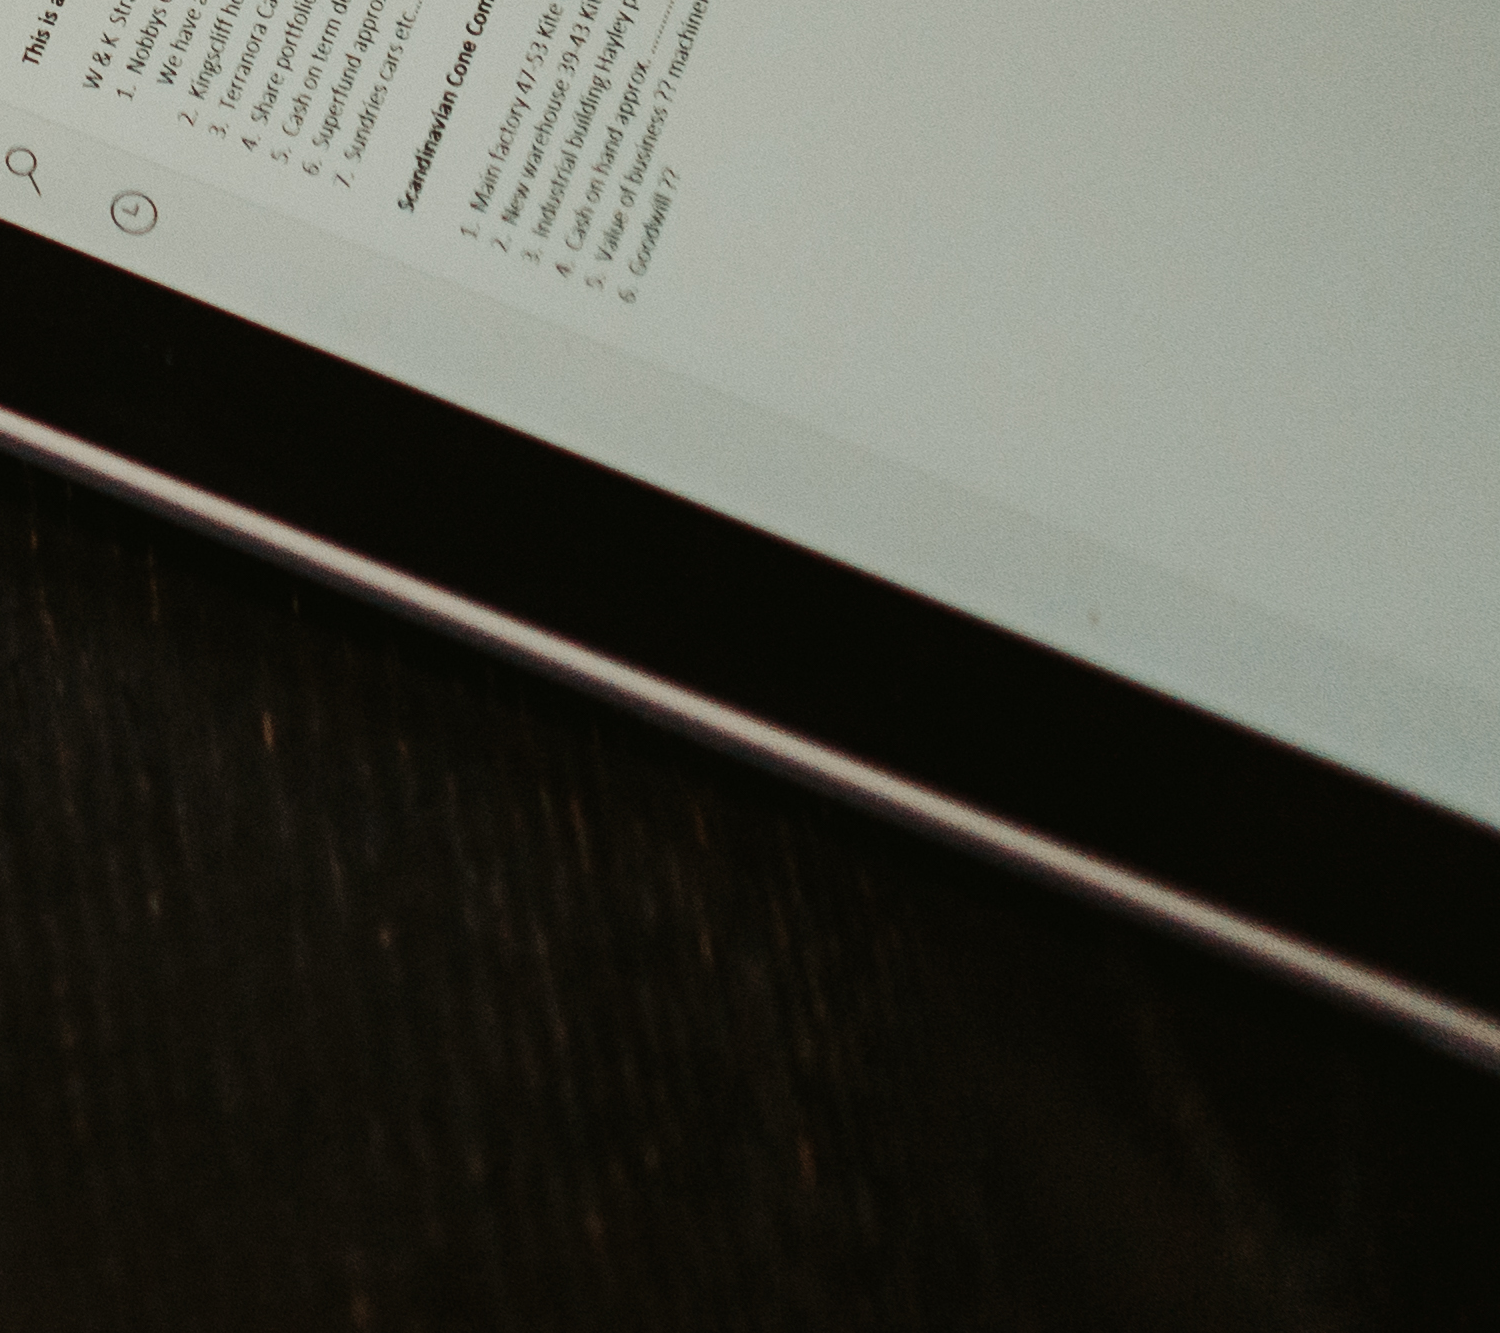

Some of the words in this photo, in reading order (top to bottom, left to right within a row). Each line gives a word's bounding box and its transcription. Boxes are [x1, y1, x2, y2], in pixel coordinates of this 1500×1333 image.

[21, 28, 51, 64] This
[37, 10, 58, 26] is
[91, 51, 112, 66] &
[101, 32, 117, 47] K
[125, 8, 166, 74] Nobbys
[157, 55, 178, 85] We
[169, 7, 199, 52] have
[189, 17, 231, 99] Kingscliff
[310, 17, 341, 61] term
[83, 67, 103, 89] W
[218, 22, 267, 109] Terranora
[302, 65, 322, 90] on
[653, 78, 675, 101] ??
[250, 72, 281, 122] Share
[281, 93, 311, 136] Cash
[311, 53, 362, 146] Superfund
[343, 84, 387, 159] Sundries
[378, 44, 403, 81] cars
[468, 165, 499, 212] Main
[488, 96, 530, 161] factory
[515, 40, 548, 94] 47-53
[536, 3, 560, 39] Kite
[500, 182, 529, 224] New
[523, 79, 566, 178] warehouse
[559, 22, 590, 71] 39-43
[397, 90, 455, 210] Scandinavian
[445, 40, 476, 87] Cone
[533, 150, 576, 237] Industrial
[566, 74, 611, 148] building
[595, 10, 634, 72] Hayley
[625, 106, 667, 184] business
[593, 125, 623, 175] hand
[585, 178, 603, 203] on
[619, 184, 635, 207] of
[564, 206, 592, 250] Cash
[596, 211, 624, 261] Value
[628, 192, 671, 275] Goodwill
[658, 165, 679, 190] ??
